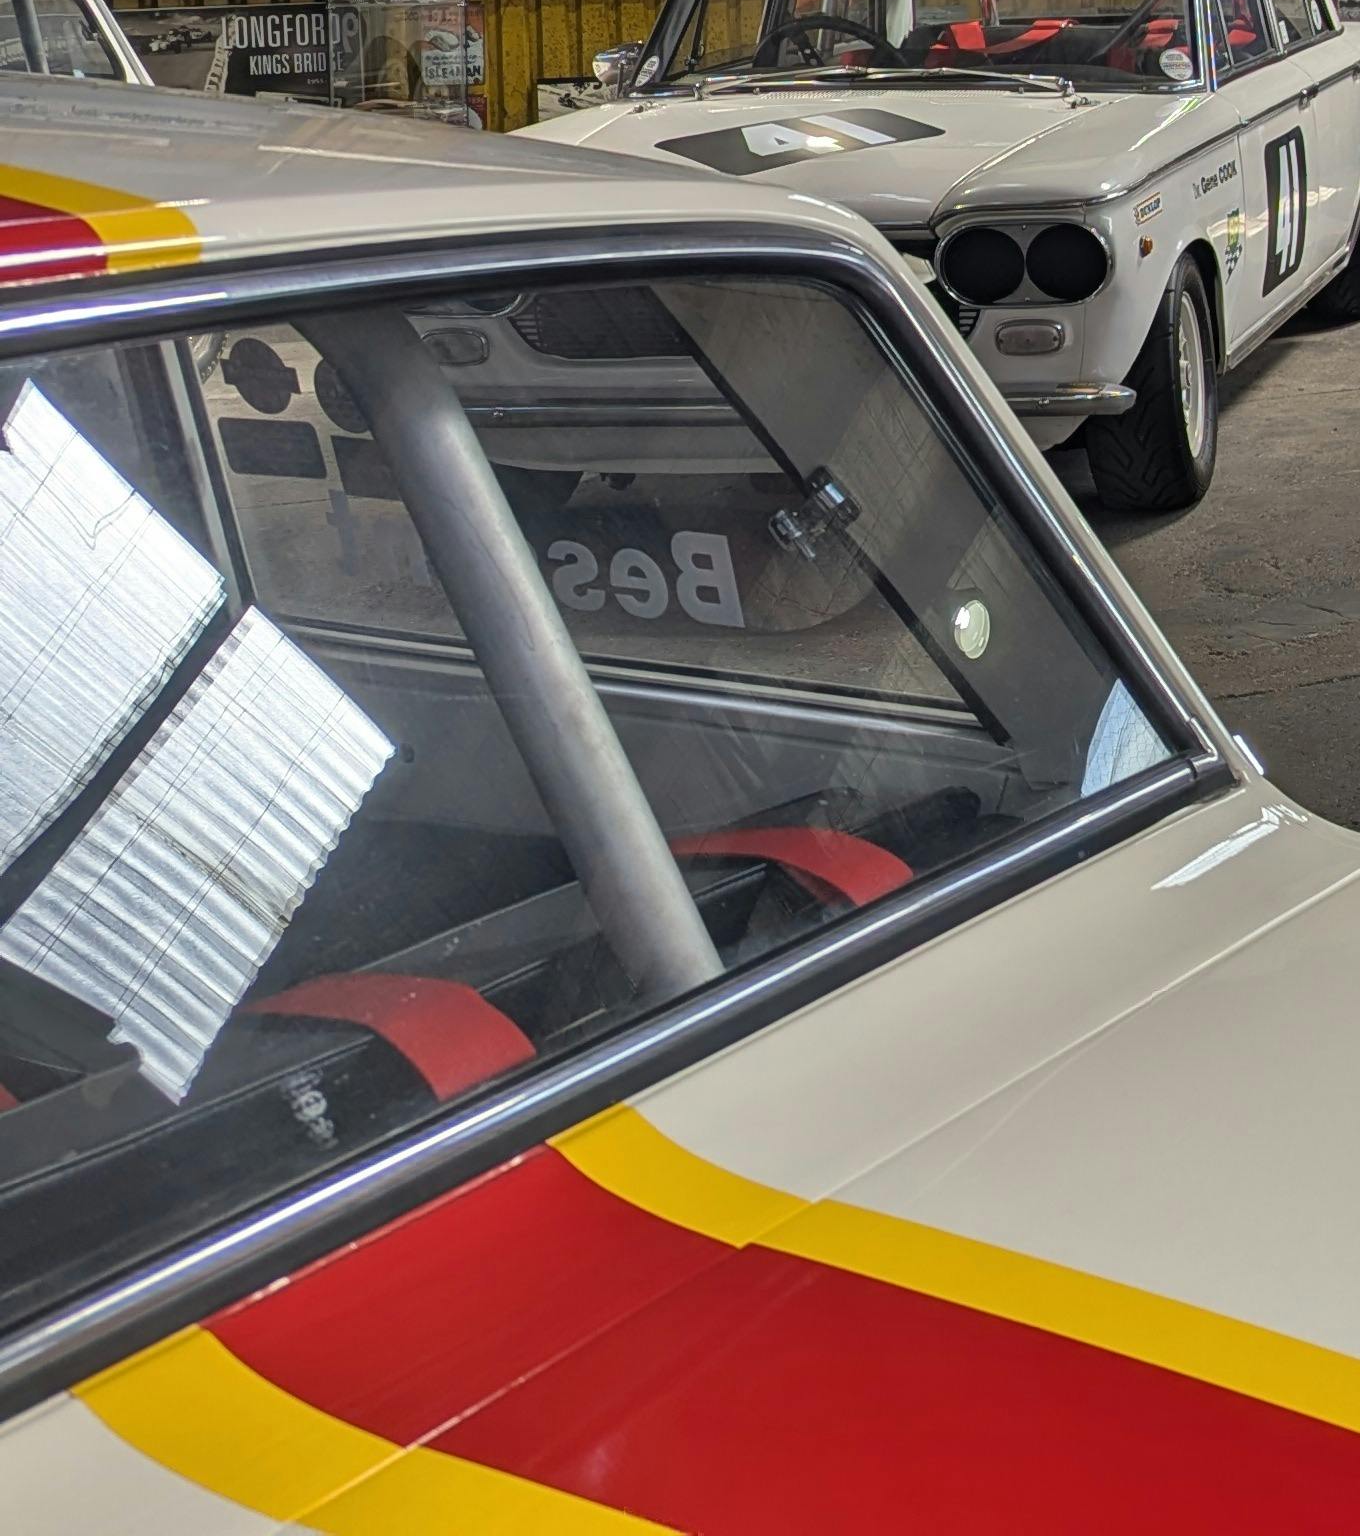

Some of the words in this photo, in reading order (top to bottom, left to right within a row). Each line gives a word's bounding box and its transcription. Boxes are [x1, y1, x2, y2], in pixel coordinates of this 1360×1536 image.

[221, 13, 340, 49] LONGFORD
[249, 53, 290, 75] KINGS
[294, 51, 344, 74] BRIDE
[1201, 173, 1218, 195] Gene
[1218, 160, 1238, 182] COOK
